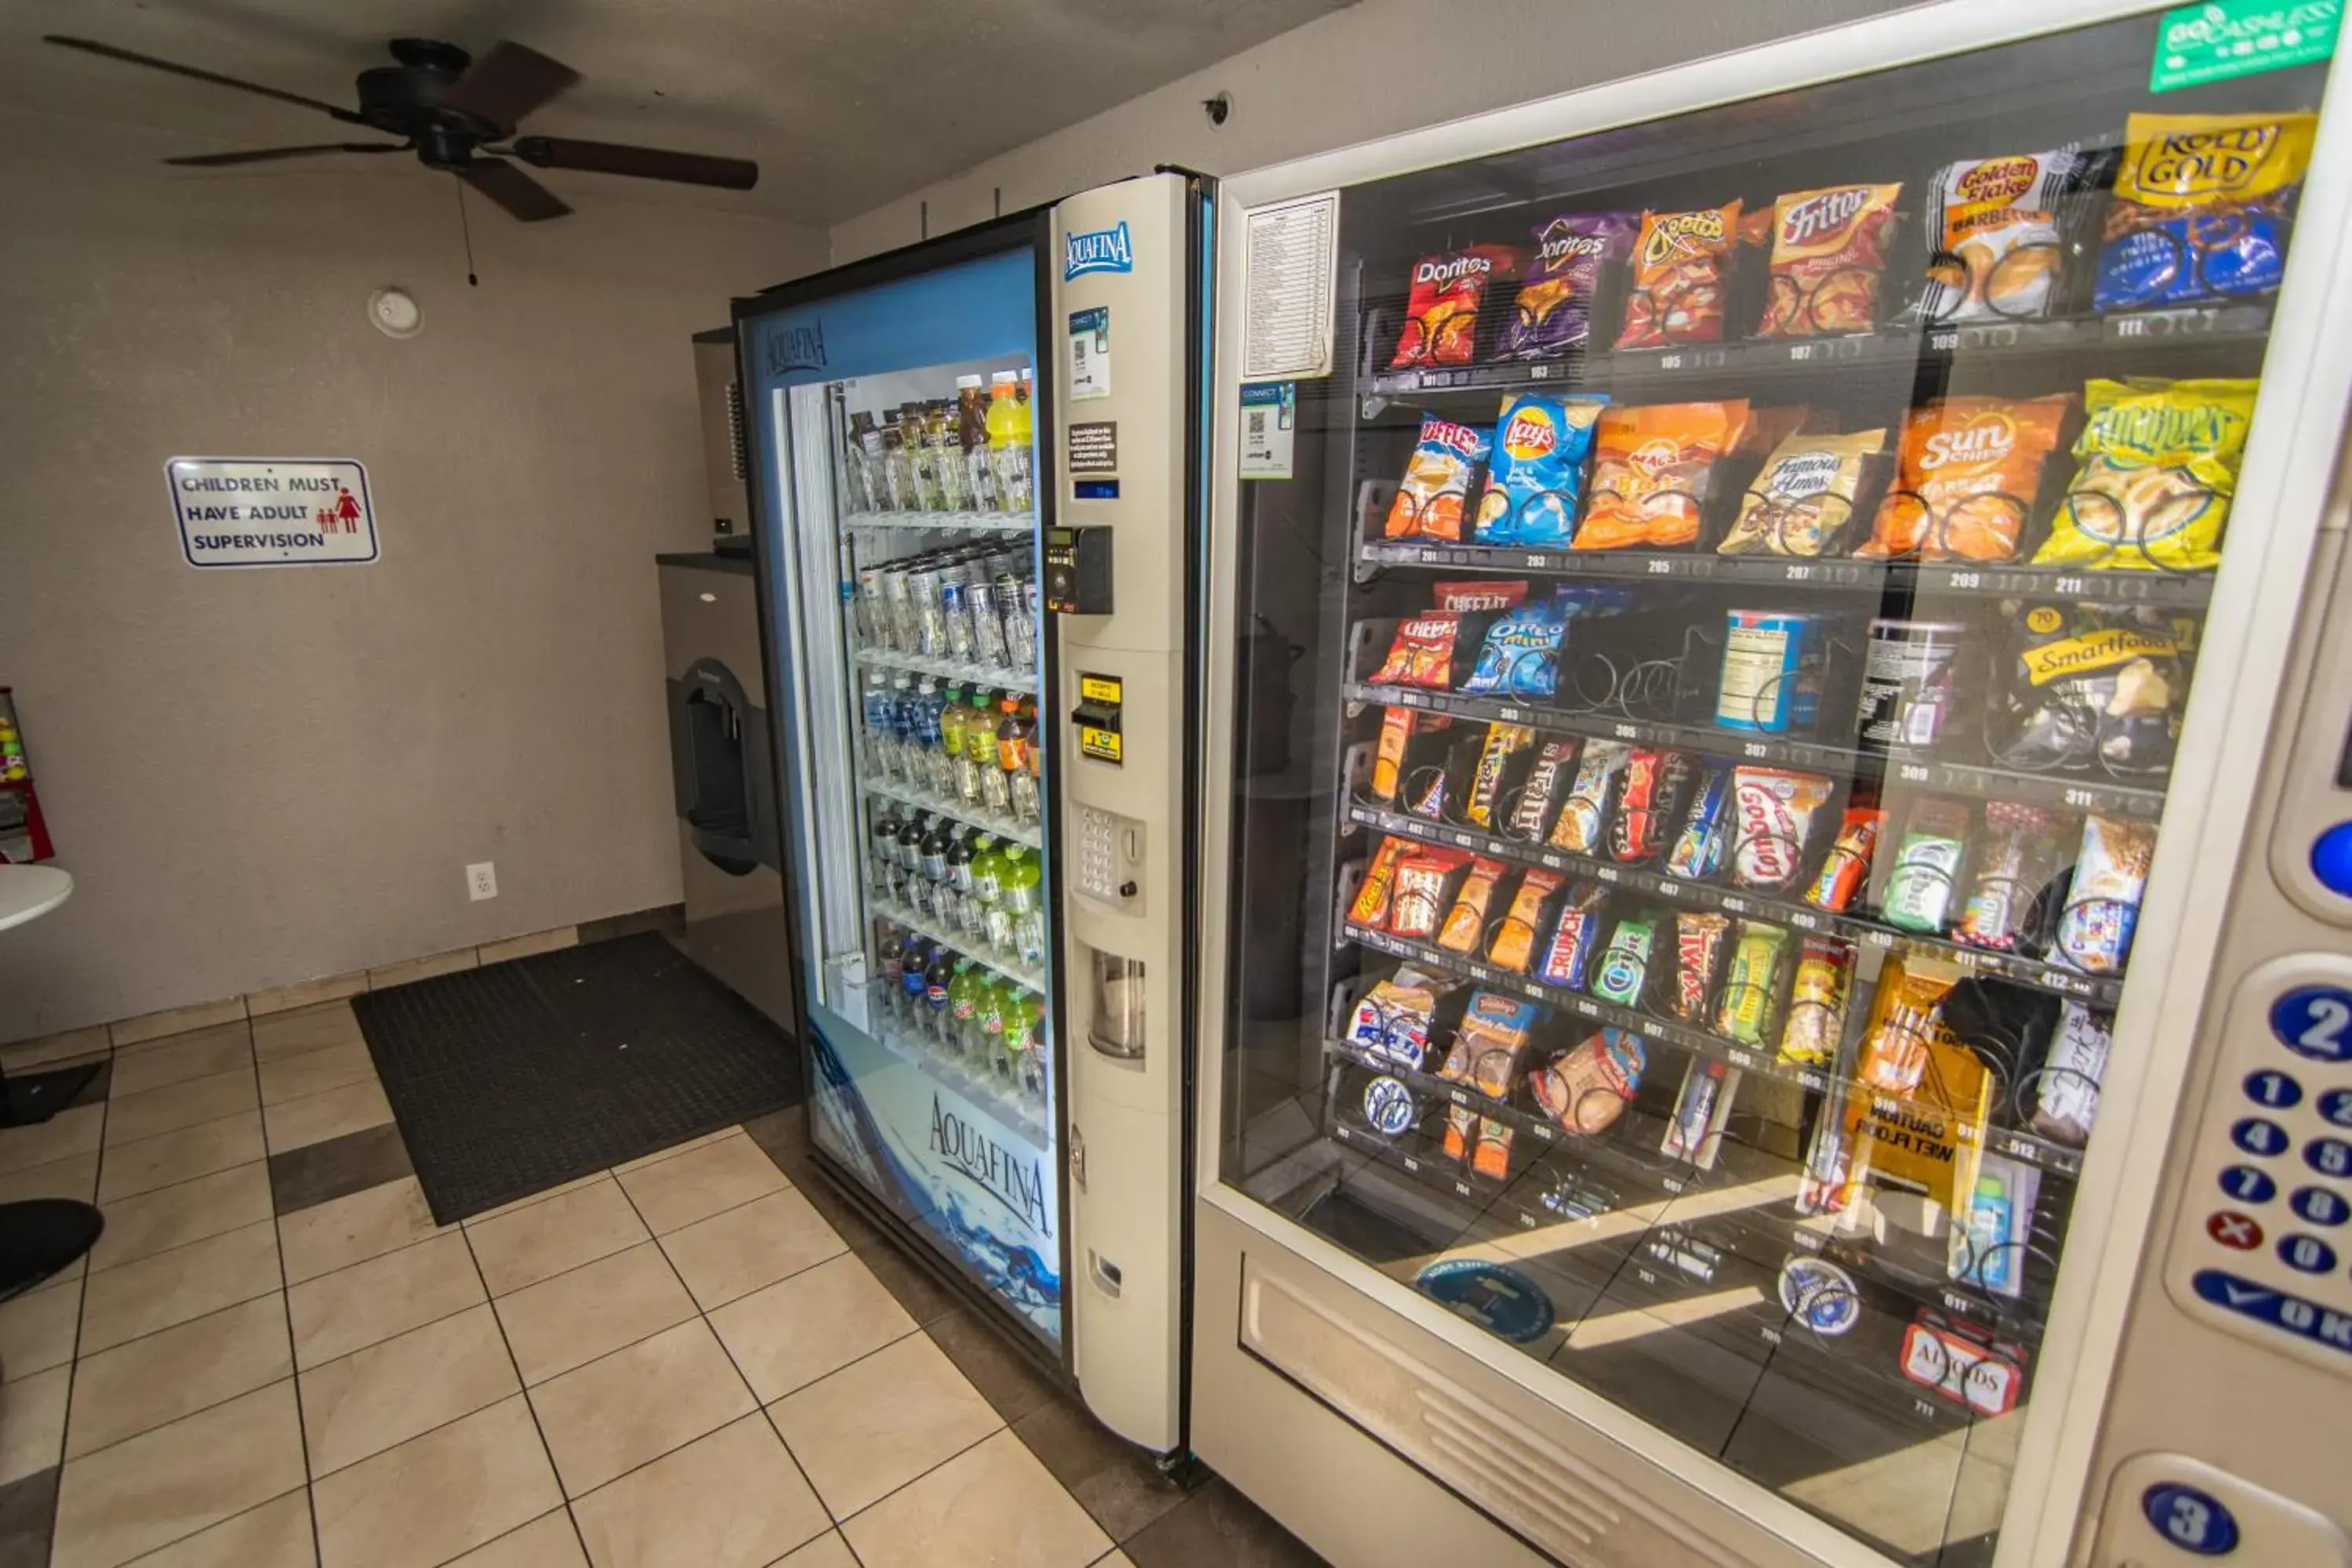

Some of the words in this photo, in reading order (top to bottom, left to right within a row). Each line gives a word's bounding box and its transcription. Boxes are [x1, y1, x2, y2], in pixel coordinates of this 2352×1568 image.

[1962, 160, 2034, 193] Golden
[2150, 155, 2249, 185] GOLD
[1966, 179, 2031, 205] Flake
[1784, 187, 1869, 246] Fritos
[1066, 222, 1129, 270] AQUAFINA
[1417, 256, 1491, 284] Doritos
[2118, 319, 2143, 336] 111
[766, 318, 827, 375] AQUAFINA
[1931, 334, 1958, 350] 109
[1791, 345, 1812, 360] 107
[1661, 355, 1682, 369] 105
[1531, 365, 1548, 379] 103
[1507, 418, 1555, 449] Lay's
[1919, 424, 2013, 469] Sun
[1947, 445, 2009, 462] CHIPS
[1774, 455, 1842, 475] Famous
[181, 477, 279, 492] CHILDREN
[289, 477, 340, 492] MUST
[1774, 472, 1828, 493] Amos
[187, 506, 239, 521] HAVE
[249, 505, 308, 521] ADULT
[194, 533, 325, 550] SUPERVISION
[1421, 551, 1437, 562] 201
[1528, 555, 1545, 568] 203
[1649, 561, 1670, 574] 205
[1786, 566, 1809, 580] 207
[1949, 572, 1979, 588] 209
[2055, 577, 2082, 593] 211
[1492, 622, 1566, 638] OREO
[1504, 634, 1551, 647] mini
[2038, 628, 2168, 672] Smartfood
[1500, 708, 1519, 720] 303
[1615, 724, 1637, 738] 305
[1744, 743, 1767, 757] 307
[1901, 765, 1928, 781] 309
[2066, 789, 2092, 807] 311
[1659, 881, 1679, 896] 407
[1791, 913, 1817, 930] 409
[1548, 907, 1584, 978] CRUNCH
[1679, 928, 1708, 1004] TWIX
[1955, 950, 1977, 967] 411
[2041, 971, 2070, 991] 412
[1643, 1022, 1663, 1037] 507
[2299, 997, 2350, 1055] 2
[1729, 1050, 1751, 1066] 508
[1796, 1071, 1821, 1088] 509
[2263, 1076, 2281, 1104] 1
[2332, 1091, 2352, 1123] 2
[2245, 1123, 2270, 1151] 4
[2010, 1139, 2037, 1158] 512
[2318, 1141, 2346, 1172] 5
[928, 1090, 1053, 1239] AQUAFINA
[2238, 1168, 2259, 1197] 7
[2306, 1189, 2333, 1219] 8
[2293, 1238, 2320, 1266] 0
[2280, 1296, 2352, 1346] OK
[1918, 1342, 1998, 1392] ALTOIDS
[2168, 1494, 2209, 1544] 3
